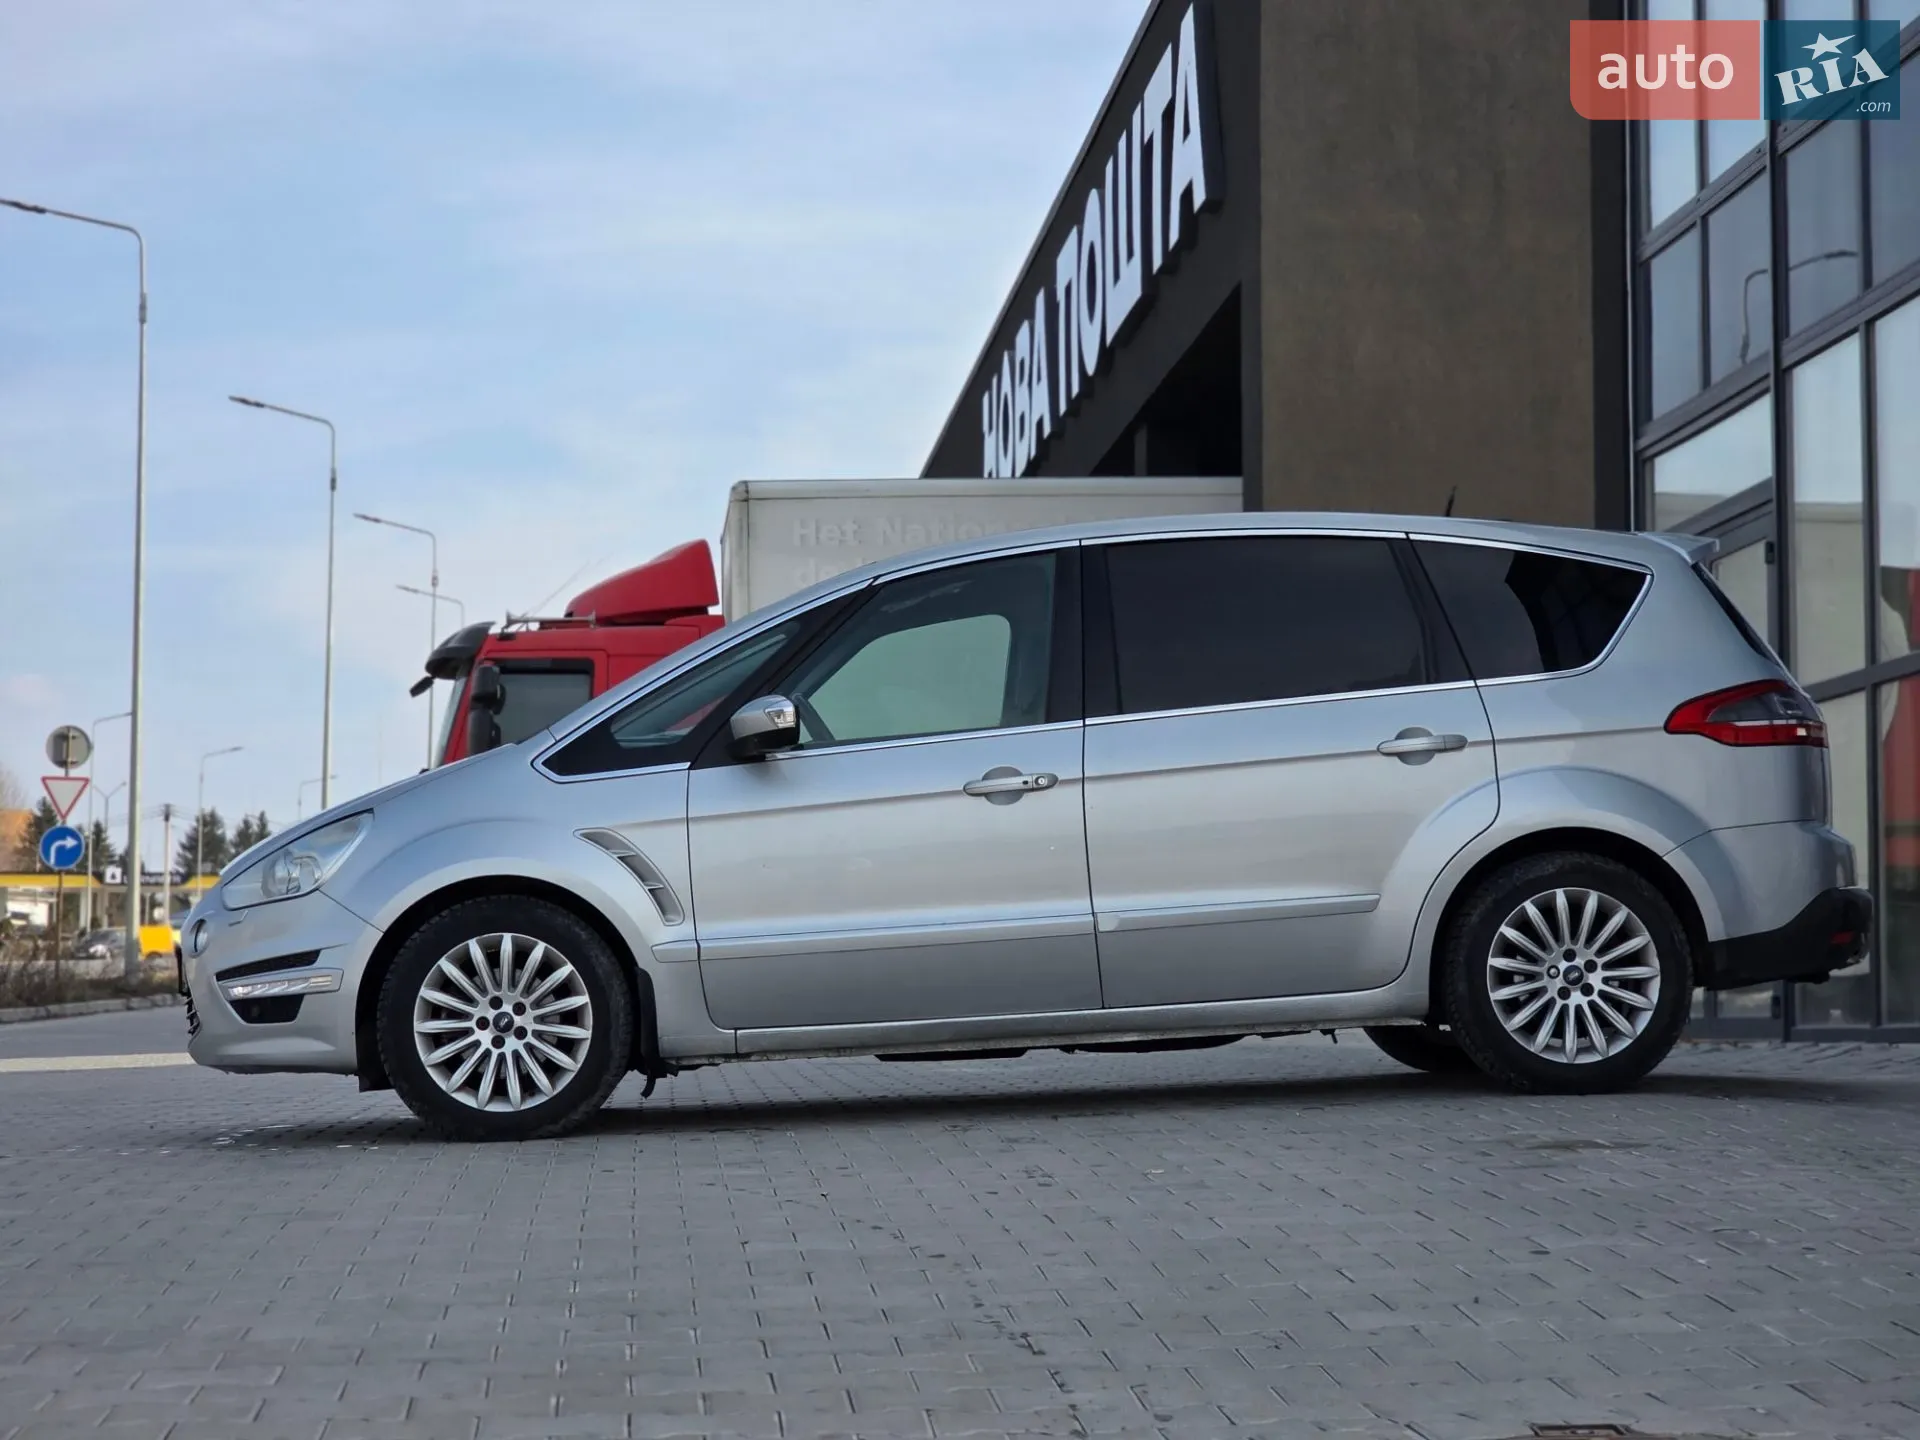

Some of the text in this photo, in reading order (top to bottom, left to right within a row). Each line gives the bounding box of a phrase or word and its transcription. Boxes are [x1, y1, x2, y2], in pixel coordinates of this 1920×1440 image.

[982, 3, 1207, 478] НОВА ПОШТА
[793, 517, 859, 547] Het
